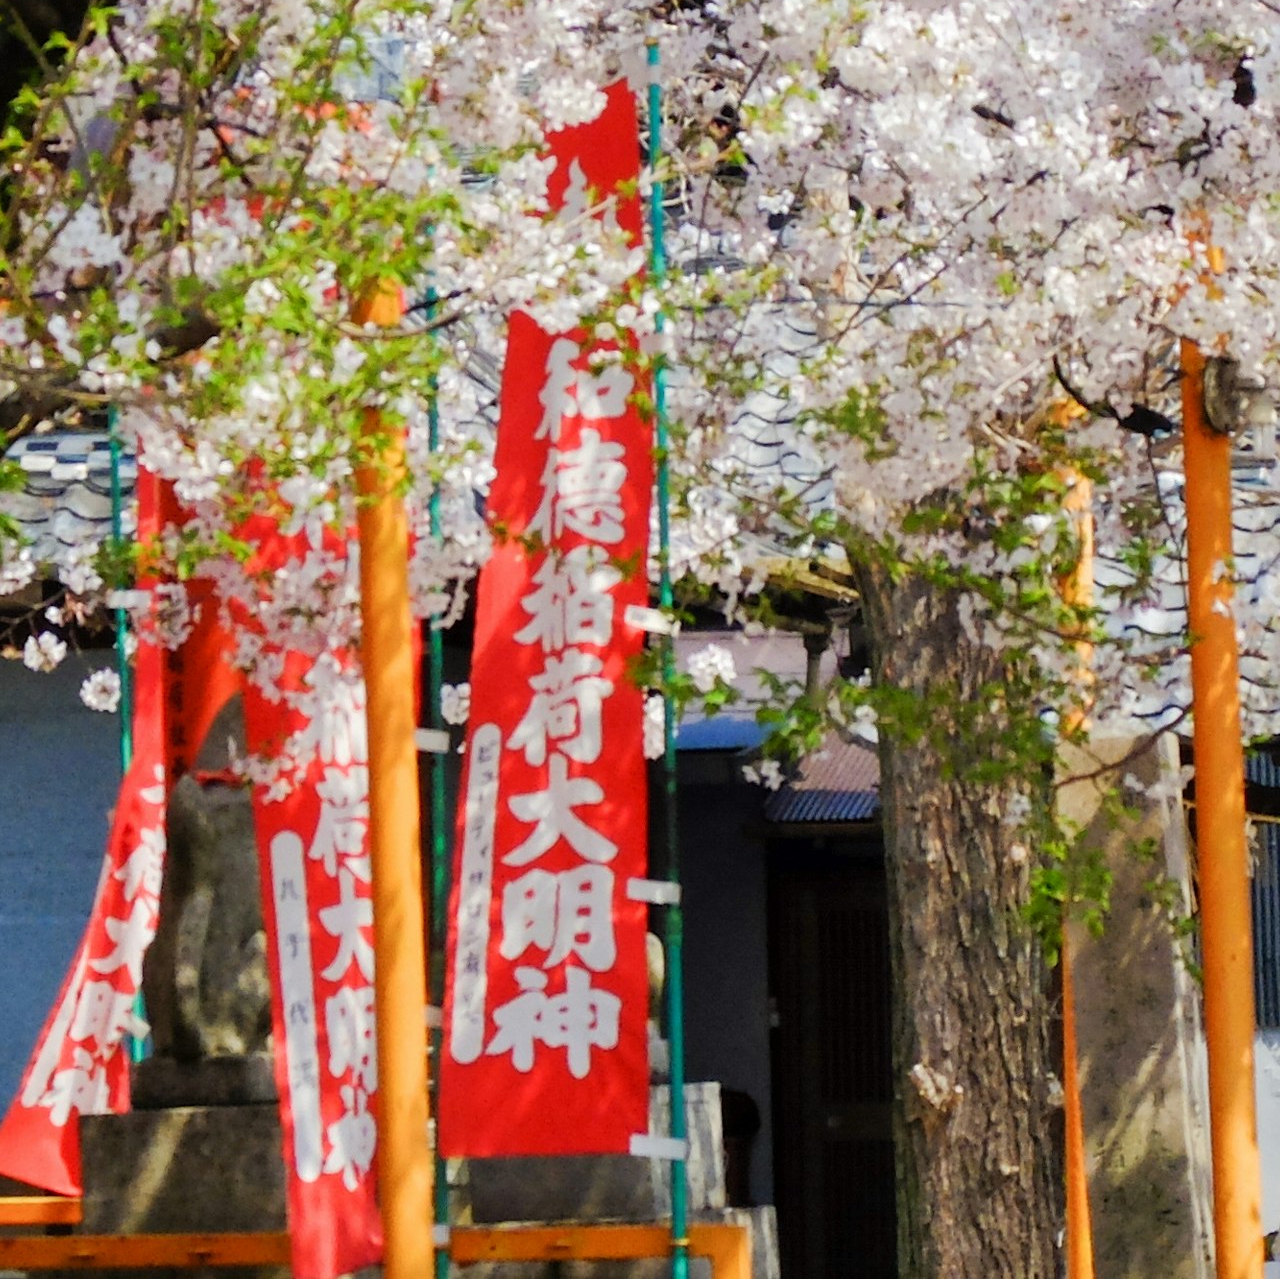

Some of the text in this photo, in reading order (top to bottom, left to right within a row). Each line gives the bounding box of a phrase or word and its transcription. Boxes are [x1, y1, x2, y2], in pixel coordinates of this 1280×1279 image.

[488, 337, 635, 1079] 和徳稲荷大明神
